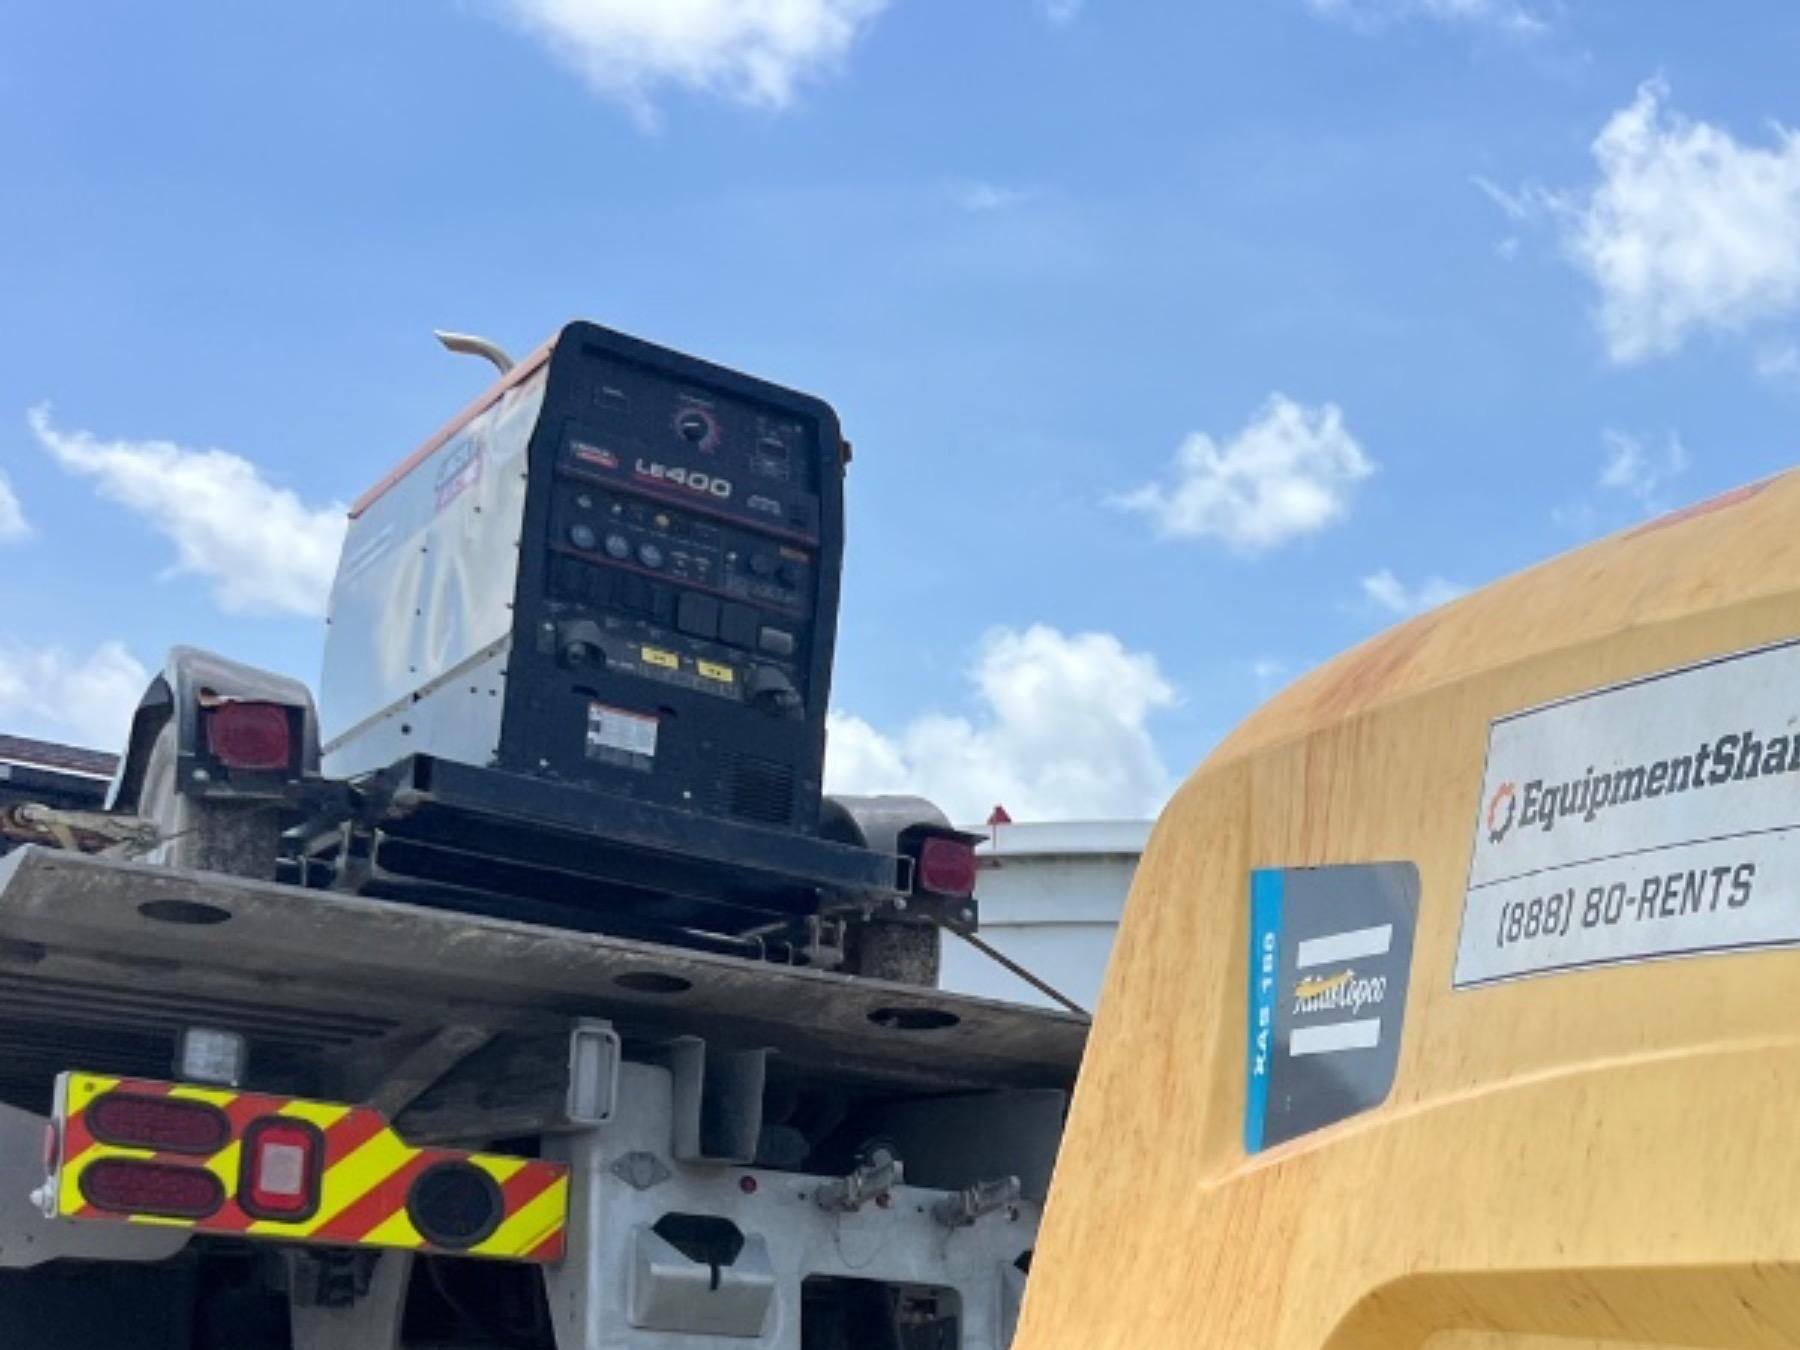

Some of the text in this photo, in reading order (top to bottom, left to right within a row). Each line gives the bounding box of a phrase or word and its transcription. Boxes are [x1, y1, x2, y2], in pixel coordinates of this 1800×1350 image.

[634, 458, 732, 499] LE400
[1497, 862, 1756, 949] (888) 80-RENTS
[1254, 931, 1275, 1077] XAS 180
